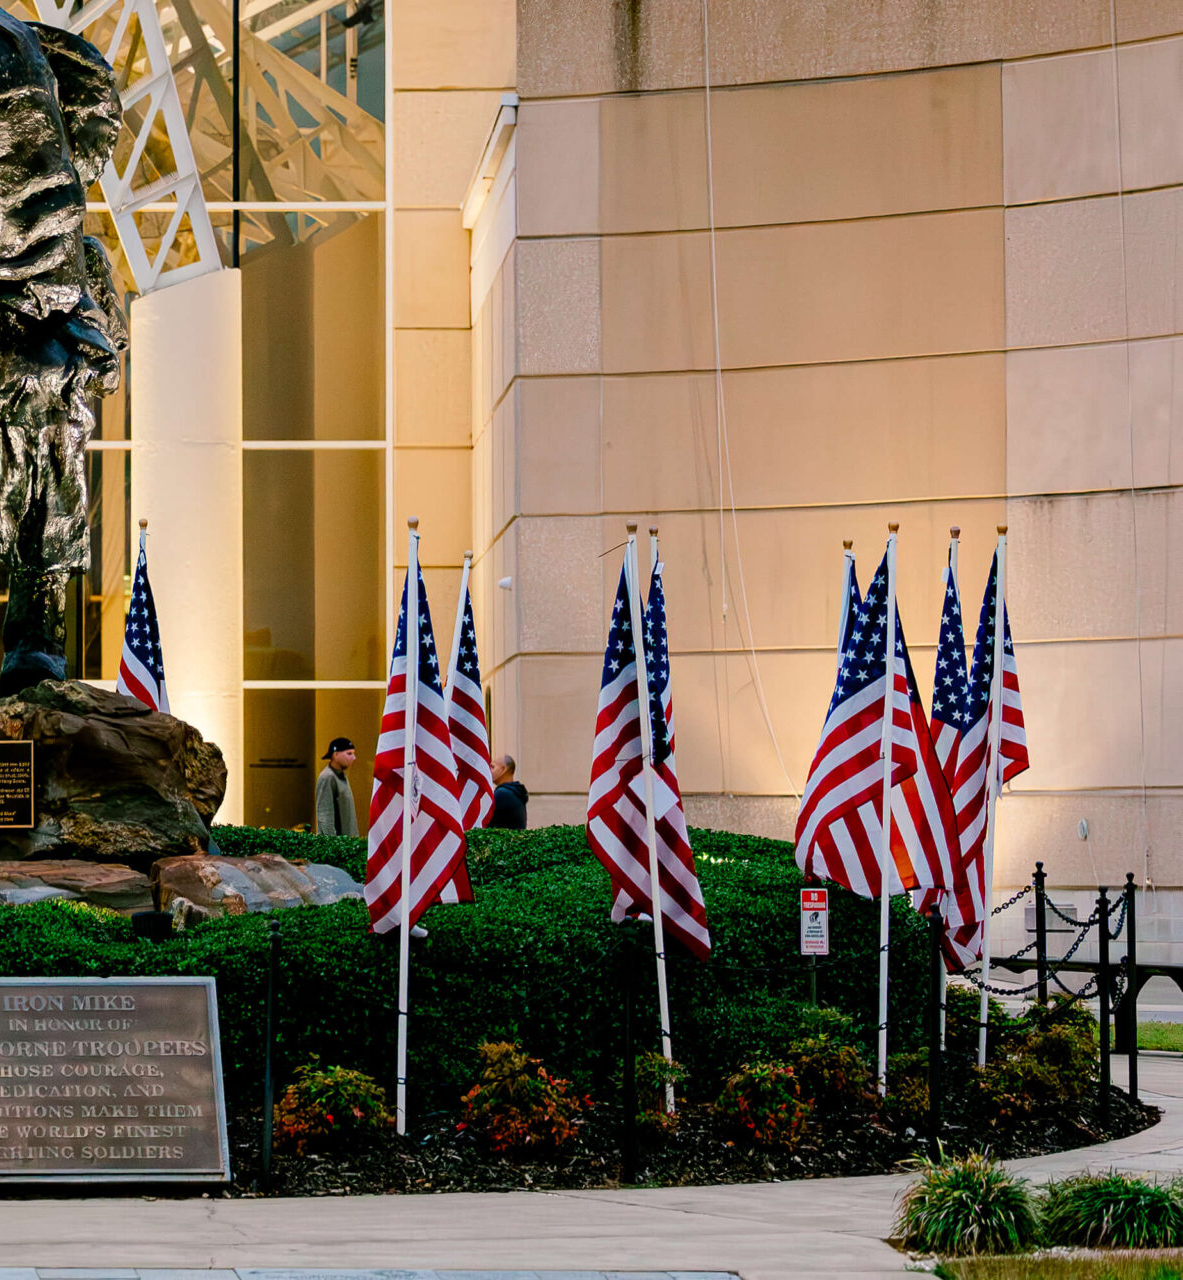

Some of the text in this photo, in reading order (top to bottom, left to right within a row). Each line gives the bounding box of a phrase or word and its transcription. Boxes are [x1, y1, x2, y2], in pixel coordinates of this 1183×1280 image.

[2, 995, 135, 1012] IRON MIKE
[8, 1018, 133, 1031] IN HONOR OF
[72, 1039, 207, 1057] TROOPERS
[60, 1063, 165, 1078] COURAGE,
[123, 1083, 165, 1097] AND
[81, 1104, 139, 1118] MAKE
[144, 1104, 203, 1118] THEM
[17, 1124, 106, 1139] WORLD'S
[113, 1125, 186, 1138] FINEST
[81, 1146, 184, 1160] SOLDIERS
